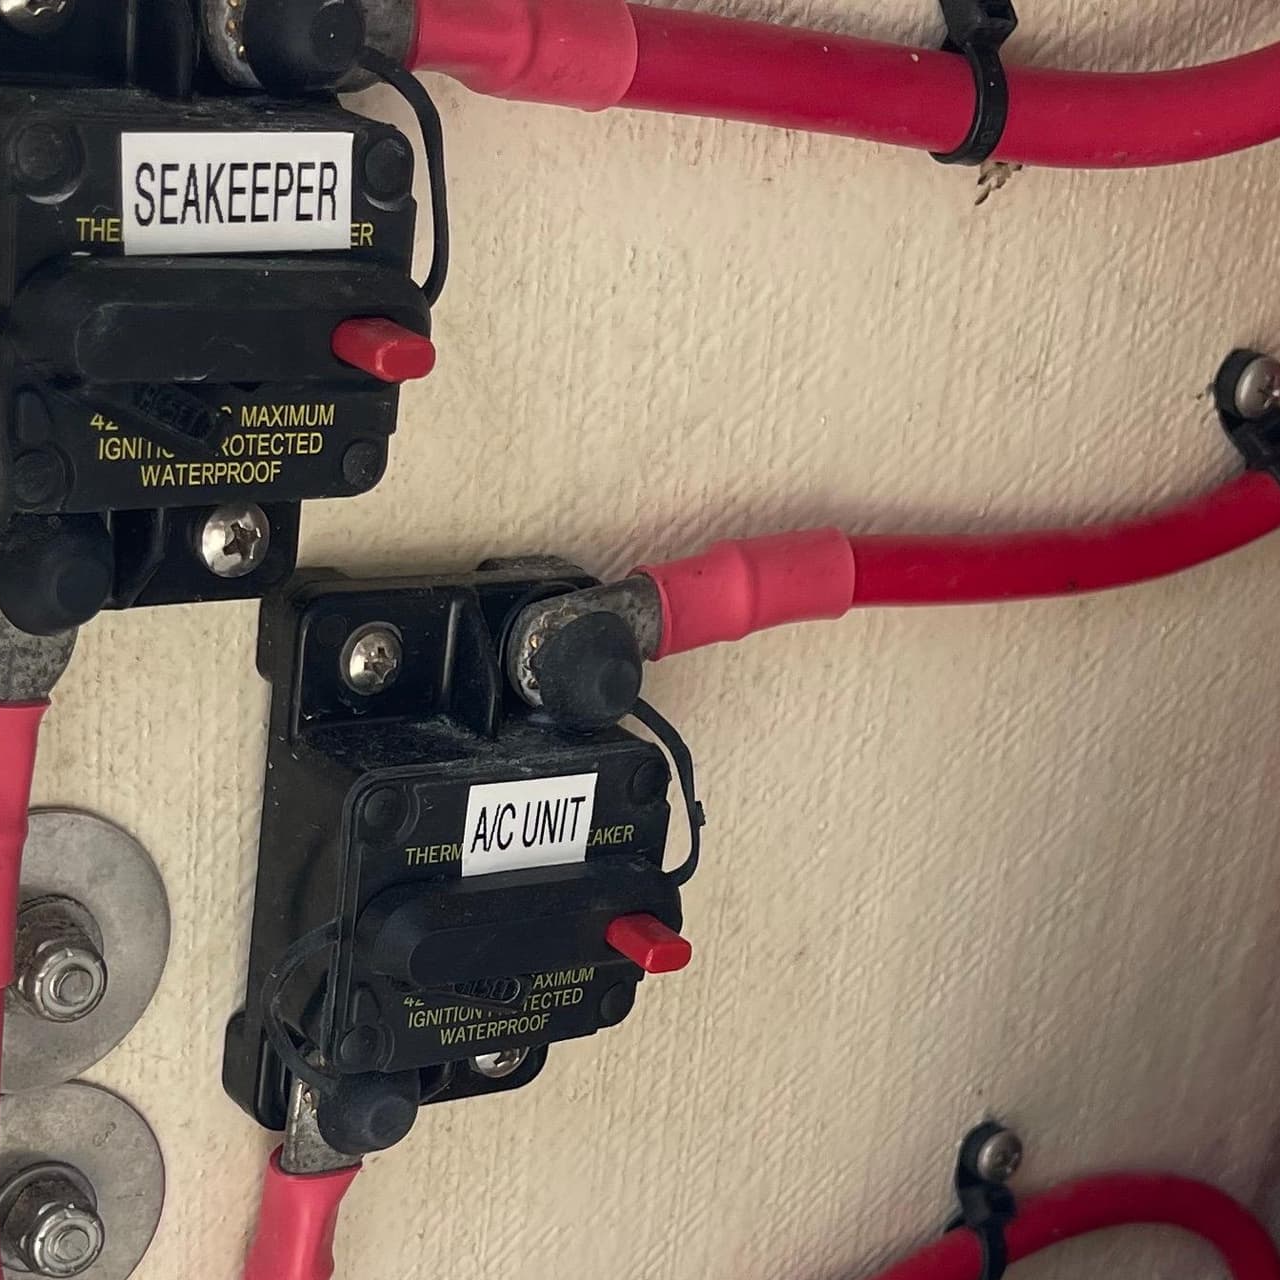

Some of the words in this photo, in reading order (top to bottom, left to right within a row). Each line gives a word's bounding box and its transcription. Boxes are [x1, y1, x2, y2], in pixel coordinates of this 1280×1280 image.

[133, 161, 339, 227] SEAKEEPER
[76, 217, 122, 242] THE
[241, 403, 335, 428] MAXIMUM
[221, 432, 323, 457] ROTECTED
[140, 460, 282, 488] WATERPROOF
[470, 803, 516, 853] A/C
[522, 796, 586, 848] UNIT
[405, 842, 464, 866] THERM
[531, 966, 595, 990] AXIMUM
[439, 1013, 551, 1045] WATERPROOF
